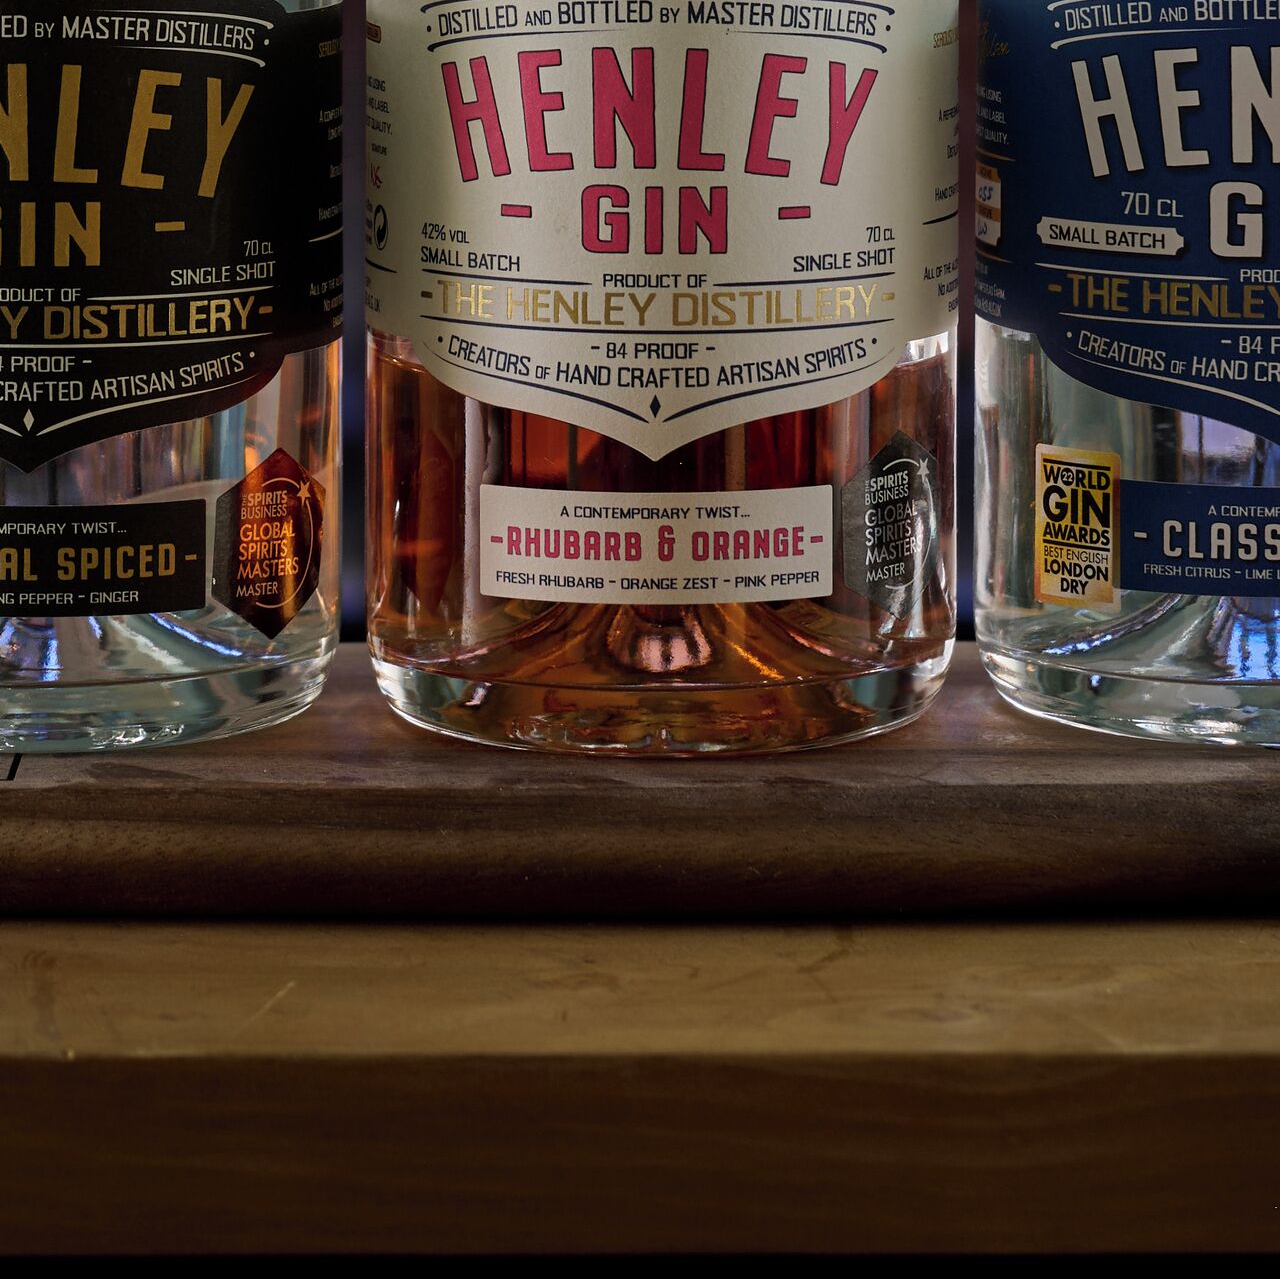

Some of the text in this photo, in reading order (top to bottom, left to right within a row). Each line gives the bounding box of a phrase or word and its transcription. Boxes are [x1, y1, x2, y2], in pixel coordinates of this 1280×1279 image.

[438, 1, 876, 37] DISTILLED AND BOTTLED MASTER DISTILLERS
[1065, 2, 1153, 32] DISTILLED
[1159, 6, 1188, 22] AND
[62, 17, 150, 42] MASTER
[156, 20, 255, 50] DISTILLERS
[440, 47, 878, 186] HENLEY
[1121, 192, 1183, 217] 70 CL
[581, 184, 728, 255] GIN
[422, 223, 469, 244] 42% VOL
[866, 226, 880, 243] 70
[1049, 224, 1166, 249] SMALL BATCH
[244, 239, 258, 256] 70
[421, 247, 520, 272] SMALL BATCH
[793, 248, 895, 273] SINGLE SHOT
[170, 261, 276, 286] SINGLE SHOT
[602, 274, 707, 289] PRODUCT OF
[60, 288, 81, 302] OF
[437, 279, 877, 326] THE HENLEY DISTILLERY
[1066, 274, 1130, 310] THE
[43, 296, 255, 339] DISTILLERY
[606, 343, 699, 360] 84 PROOF
[1078, 331, 1165, 371] CREATORS
[1192, 356, 1247, 380] HAND
[1239, 337, 1263, 354] 84
[10, 356, 76, 372] PROOF
[448, 335, 867, 388] CREATORS HAND CRAFTED ARTISAN SPIRITS
[90, 368, 176, 399] ARTISAN
[180, 352, 244, 385] SPIRITS
[870, 470, 909, 491] SPIRITS
[1043, 464, 1110, 490] WORLD
[247, 492, 288, 508] SPIRITS
[865, 486, 909, 505] BUSINESS
[240, 504, 288, 519] BUSINESS
[574, 506, 690, 519] CONTEMPORARY
[864, 503, 918, 525] GLOBAL
[1042, 488, 1111, 528] GIN
[239, 522, 295, 541] GLOBAL
[865, 522, 911, 546] SPIRITS
[1043, 522, 1110, 546] AWARDS
[239, 539, 288, 560] SPIRITS
[506, 525, 804, 562] RHUBARB & ORANGE
[865, 535, 922, 566] MASTERS
[57, 542, 177, 580] SPICED
[1043, 546, 1109, 565] BEST ENGLISH
[237, 557, 299, 578] MASTERS
[866, 563, 905, 583] MASTER
[1043, 558, 1109, 581] LONDON
[1143, 564, 1182, 577] FRESH
[1186, 565, 1230, 579] CITRUS
[1245, 568, 1273, 580] LIME
[236, 581, 279, 598] MASTER
[496, 571, 819, 590] FRESH RHUBARB ORANGE ZEST PINK PEPPER
[1060, 577, 1089, 596] DRY
[19, 593, 74, 605] PEPPER
[90, 590, 139, 603] GINGER
